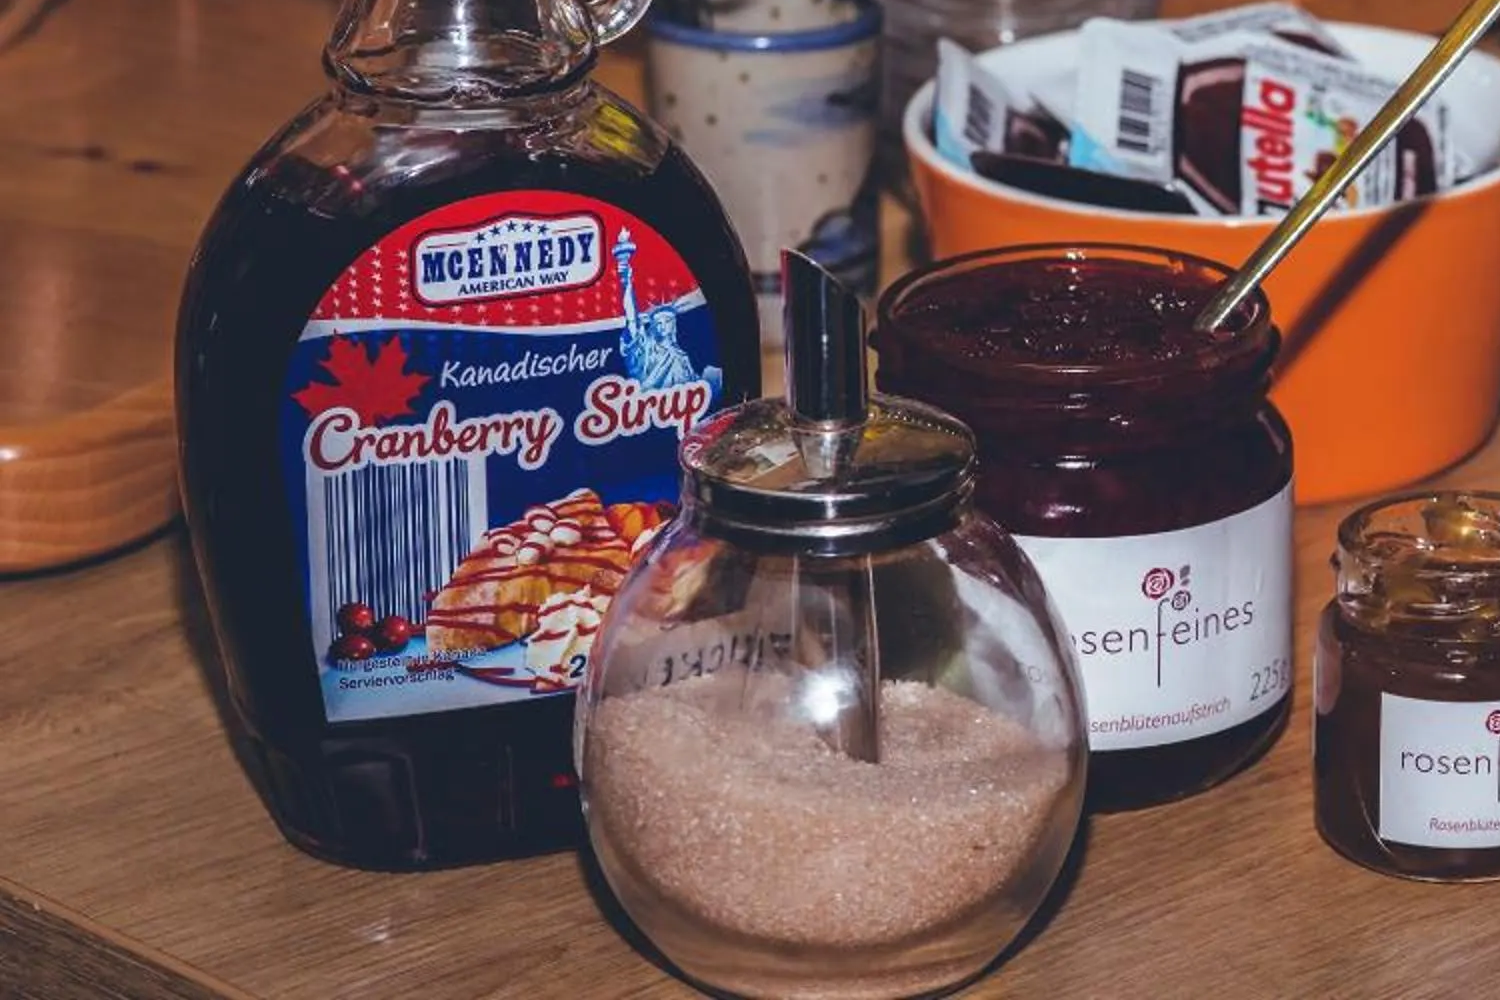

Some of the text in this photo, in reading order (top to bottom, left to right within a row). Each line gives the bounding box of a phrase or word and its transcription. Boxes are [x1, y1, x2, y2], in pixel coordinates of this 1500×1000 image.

[421, 231, 595, 284] MCENNEDY
[457, 270, 570, 297] AMERICAN WAY
[440, 343, 613, 388] Kanadischer
[307, 380, 706, 471] Cranberry Sirup
[1070, 597, 1255, 690] senfeines
